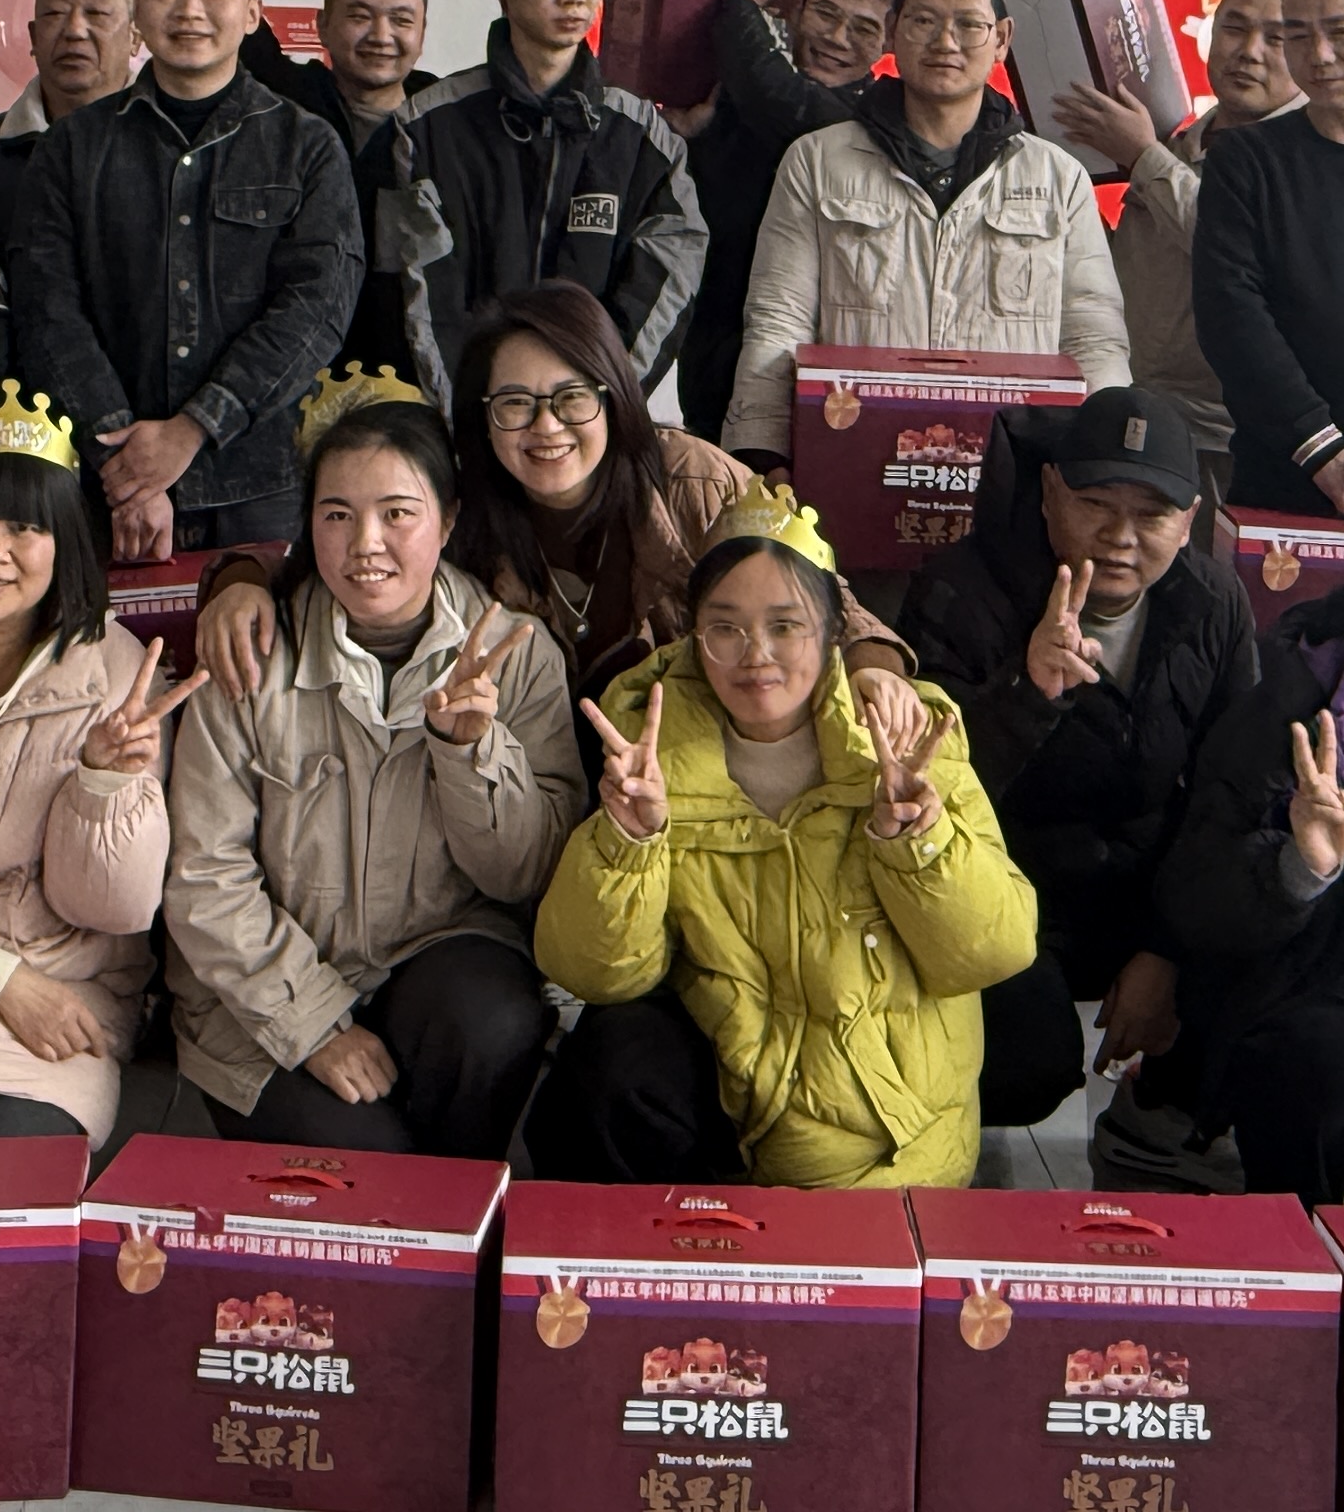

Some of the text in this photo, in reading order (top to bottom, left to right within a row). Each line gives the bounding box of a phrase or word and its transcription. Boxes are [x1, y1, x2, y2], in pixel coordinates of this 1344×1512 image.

[196, 1348, 355, 1395] 三只松鼠
[622, 1399, 789, 1440] 三只松鼠
[1046, 1400, 1211, 1441] 三只松鼠
